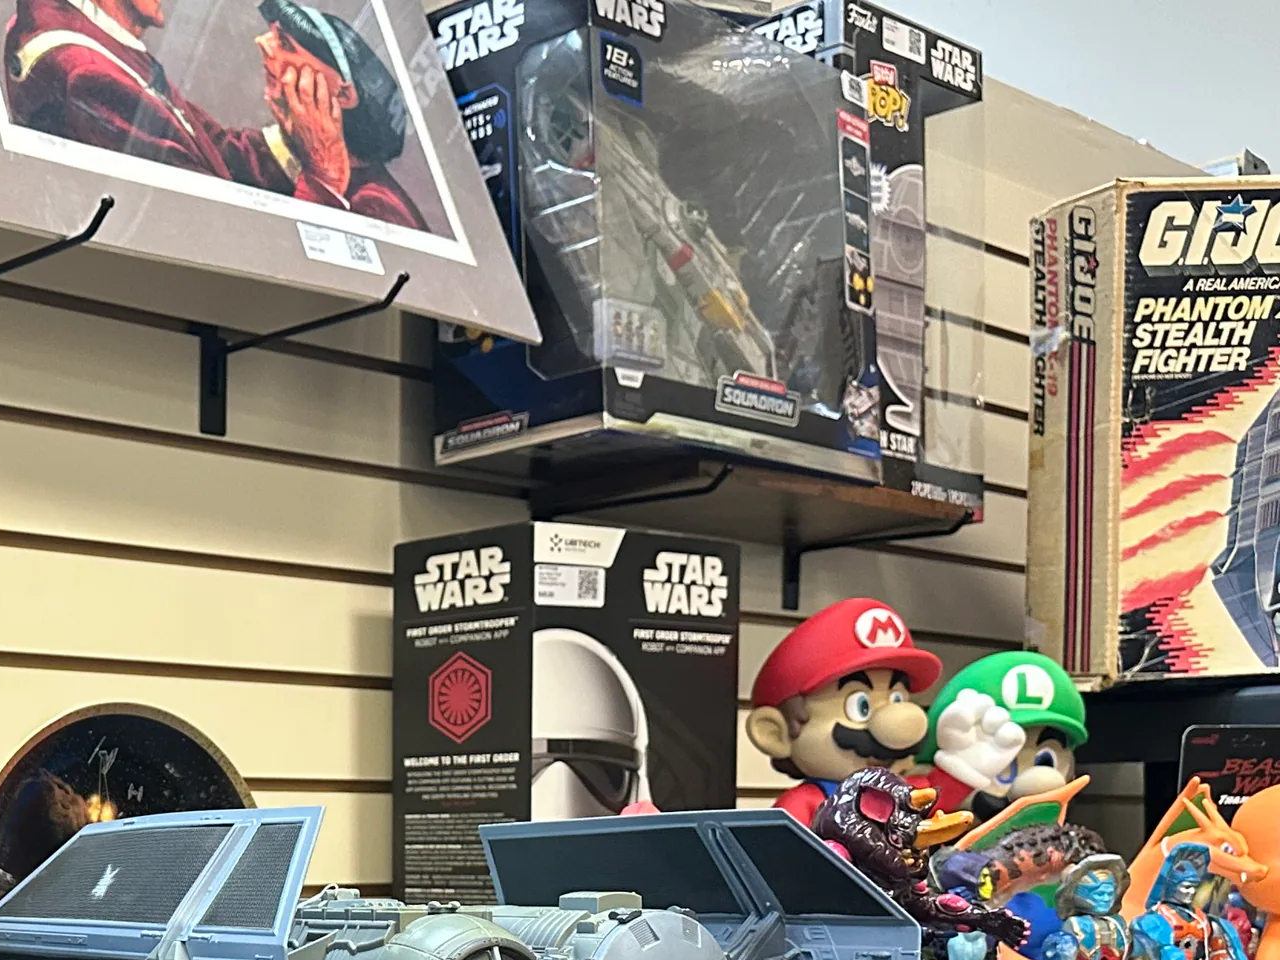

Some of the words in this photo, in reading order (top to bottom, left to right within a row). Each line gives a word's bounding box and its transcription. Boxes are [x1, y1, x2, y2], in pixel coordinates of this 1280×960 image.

[754, 10, 823, 42] TAR
[605, 45, 634, 67] 18+
[930, 39, 976, 74] STAR
[931, 56, 976, 92] WARS
[1031, 218, 1046, 328] STEALTH
[1183, 279, 1193, 291] A
[1195, 278, 1228, 291] REAL
[1133, 295, 1274, 322] PHANTOM
[1132, 321, 1257, 348] STEALTH
[1132, 347, 1251, 374] FIGHTER
[723, 387, 794, 417] SQUADRON
[1033, 352, 1046, 437] GHTER
[415, 547, 511, 585] STAR
[644, 551, 728, 587] STAR
[415, 574, 511, 612] WARS
[644, 582, 728, 617] WARS
[407, 625, 426, 638] FIRST
[428, 622, 452, 635] ORDER
[633, 629, 654, 640] FIRST
[656, 630, 678, 642] ORDER
[866, 615, 902, 644] M
[1015, 672, 1044, 705] L
[404, 755, 439, 767] WELCOME
[441, 755, 451, 765] TO
[453, 754, 467, 765] THE
[469, 754, 491, 765] FIRST
[493, 752, 520, 764] ORDER
